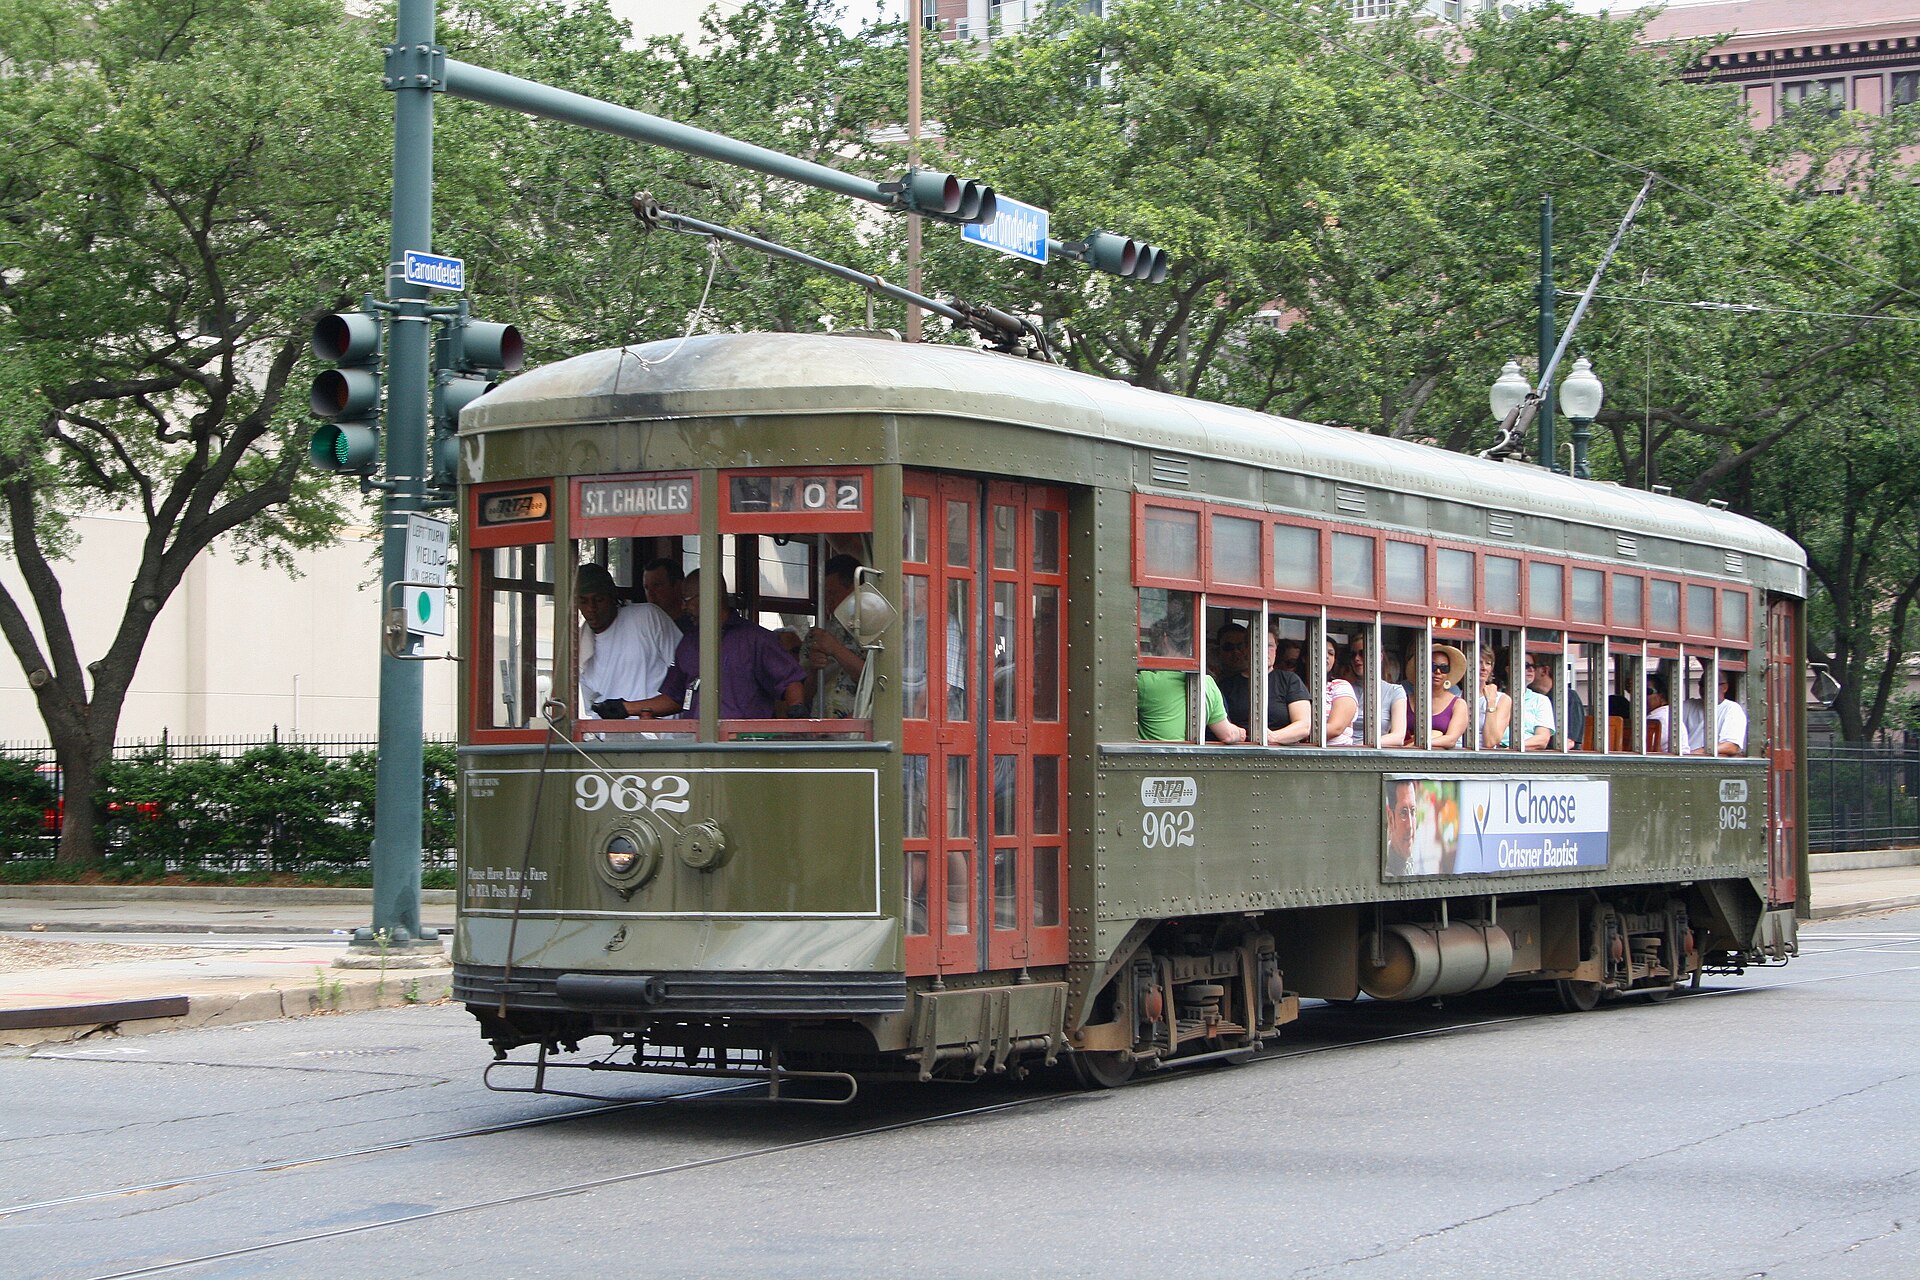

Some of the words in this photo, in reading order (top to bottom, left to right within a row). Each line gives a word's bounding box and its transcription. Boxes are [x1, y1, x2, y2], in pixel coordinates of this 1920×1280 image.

[408, 256, 461, 286] Carondelet
[586, 490, 609, 514] ST.
[612, 485, 689, 513] CHARLES
[412, 525, 428, 539] LEFT
[428, 528, 444, 543] TURN
[416, 546, 437, 566] YIELD
[575, 774, 690, 813] 962
[1152, 780, 1185, 798] RTA
[1505, 783, 1509, 824] I
[1515, 780, 1576, 824] Choose
[1142, 810, 1195, 849] 962
[1719, 805, 1747, 830] 962
[1498, 839, 1542, 869] Ochsner
[1543, 838, 1578, 868] Baptist
[467, 866, 486, 880] Please
[487, 866, 504, 880] Have
[530, 867, 548, 881] Fare
[492, 884, 508, 898] Pass
